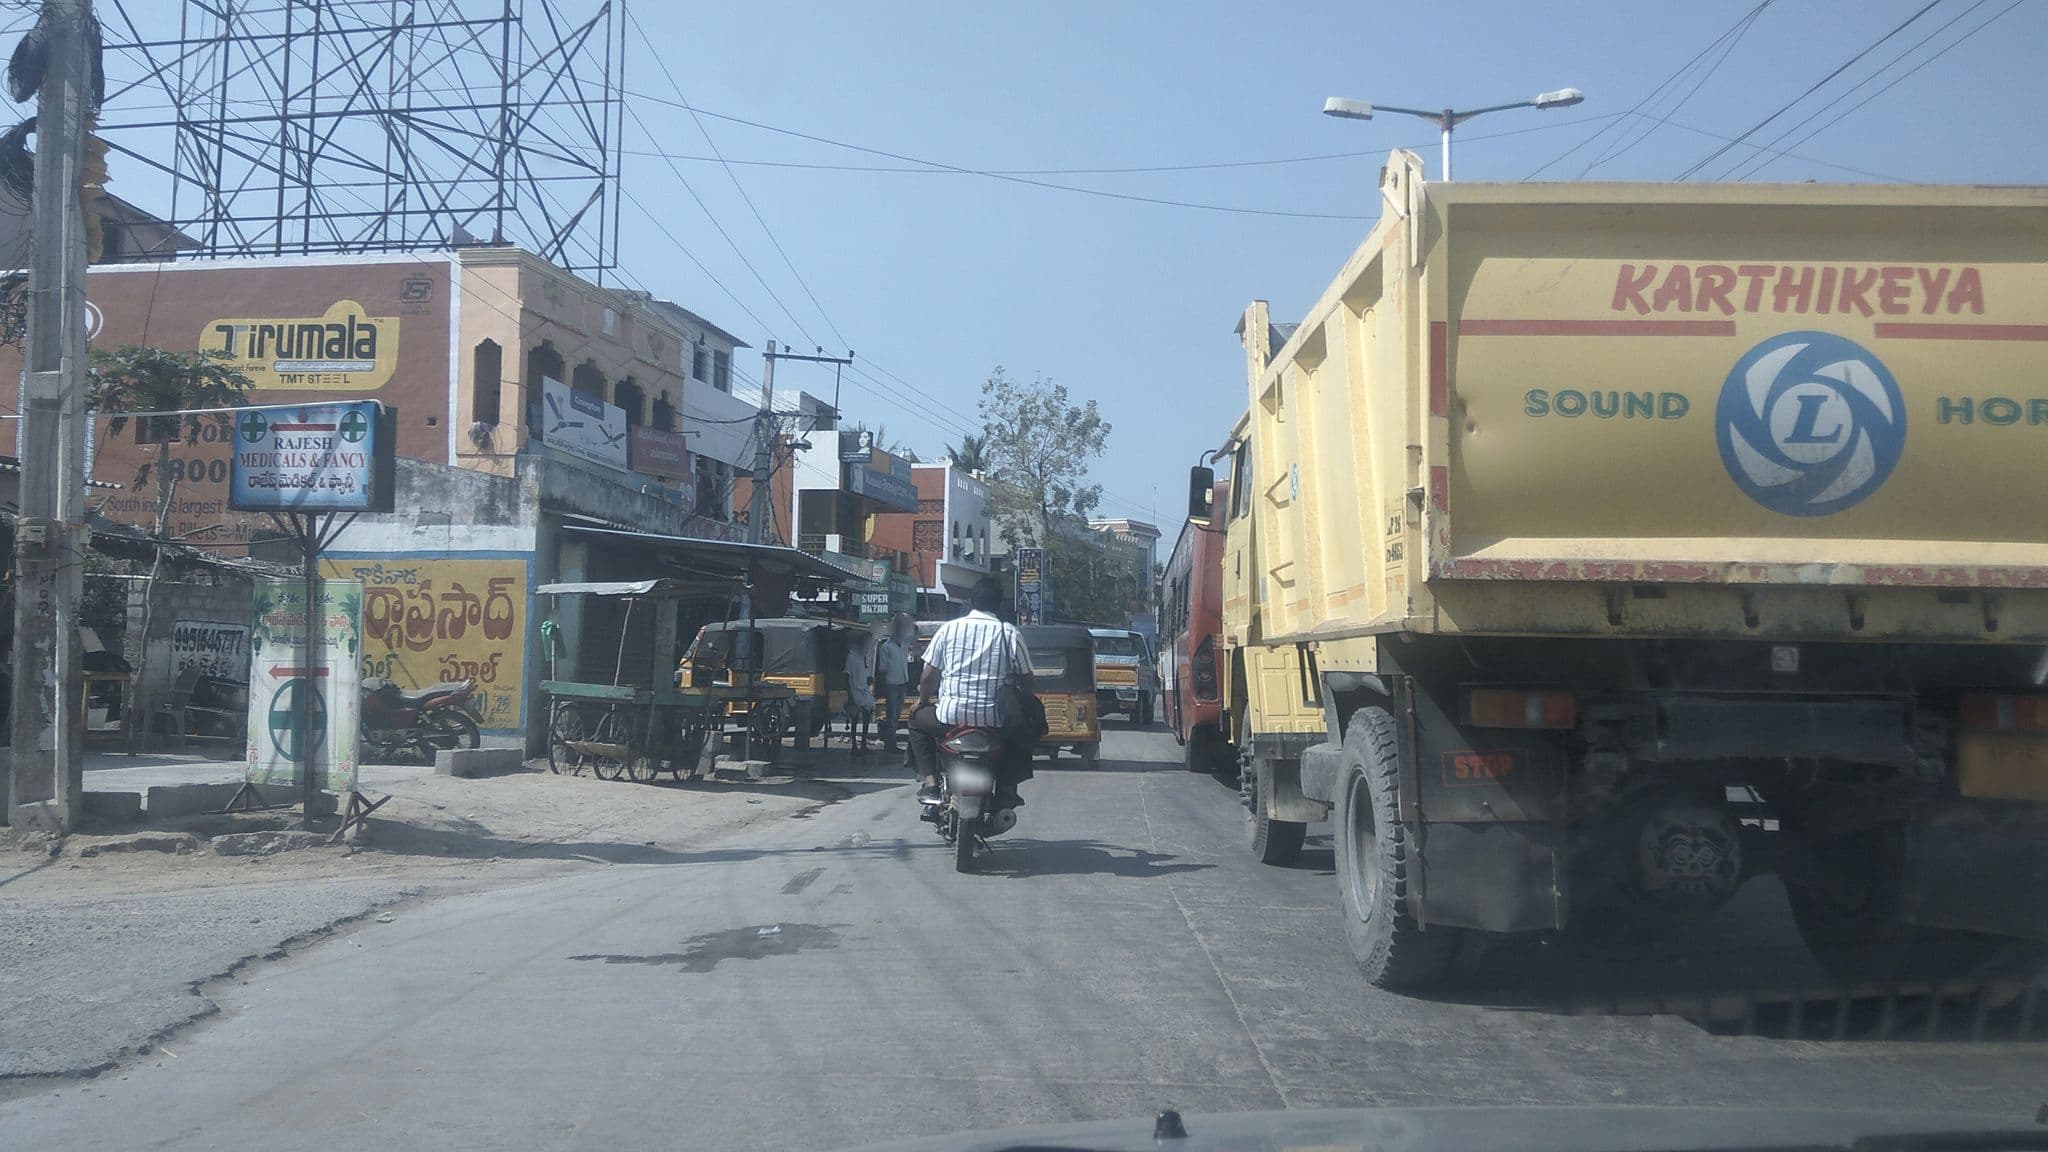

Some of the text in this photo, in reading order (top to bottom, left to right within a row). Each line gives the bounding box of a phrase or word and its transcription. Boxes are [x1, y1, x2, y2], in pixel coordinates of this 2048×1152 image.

[1611, 264, 1986, 319] KARTHIKEYA
[215, 314, 377, 360] Tirumala
[279, 373, 304, 384] TMT
[1524, 388, 1691, 421] SOUND
[274, 437, 333, 450] RAJESH
[239, 452, 367, 469] MEDICALS & FANCY
[861, 593, 889, 603] SUPER
